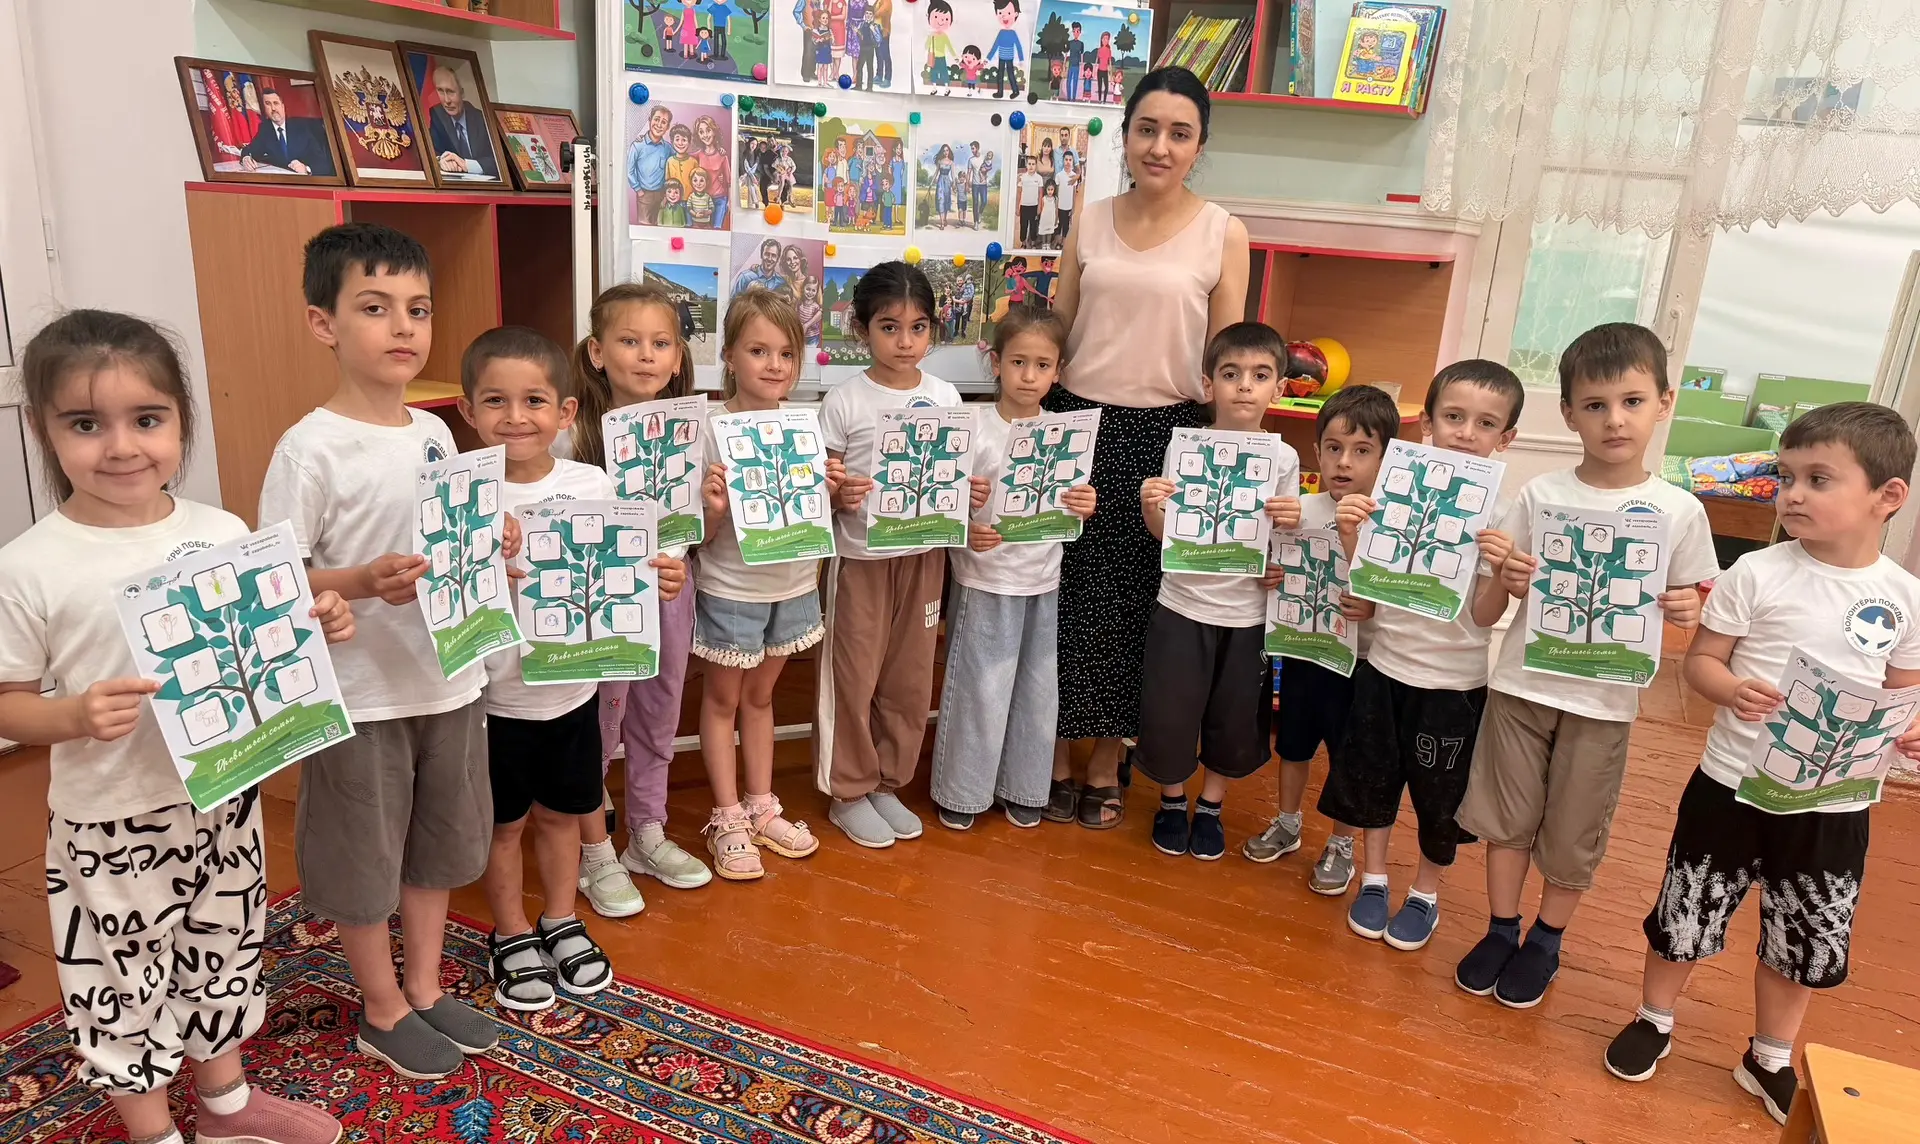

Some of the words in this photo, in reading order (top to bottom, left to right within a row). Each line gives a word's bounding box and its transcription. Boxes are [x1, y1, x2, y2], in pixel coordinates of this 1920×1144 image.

[1341, 81, 1352, 93] Я
[1355, 82, 1395, 97] РАСТУ
[1368, 574, 1390, 584] Древо
[1410, 580, 1432, 588] семьи
[1845, 598, 1877, 632] ВОЛОНТЁРЫ
[1878, 598, 1904, 624] ПОБЕДЫ
[547, 650, 572, 664] Древо
[572, 646, 594, 657] моей
[594, 643, 620, 653] семьи
[1548, 646, 1571, 656] Древо
[1571, 647, 1592, 655] моей
[1592, 648, 1617, 656] семьи
[214, 749, 244, 774] Древо
[244, 730, 268, 752] моей
[268, 714, 296, 737] семьи
[1415, 732, 1465, 771] 97
